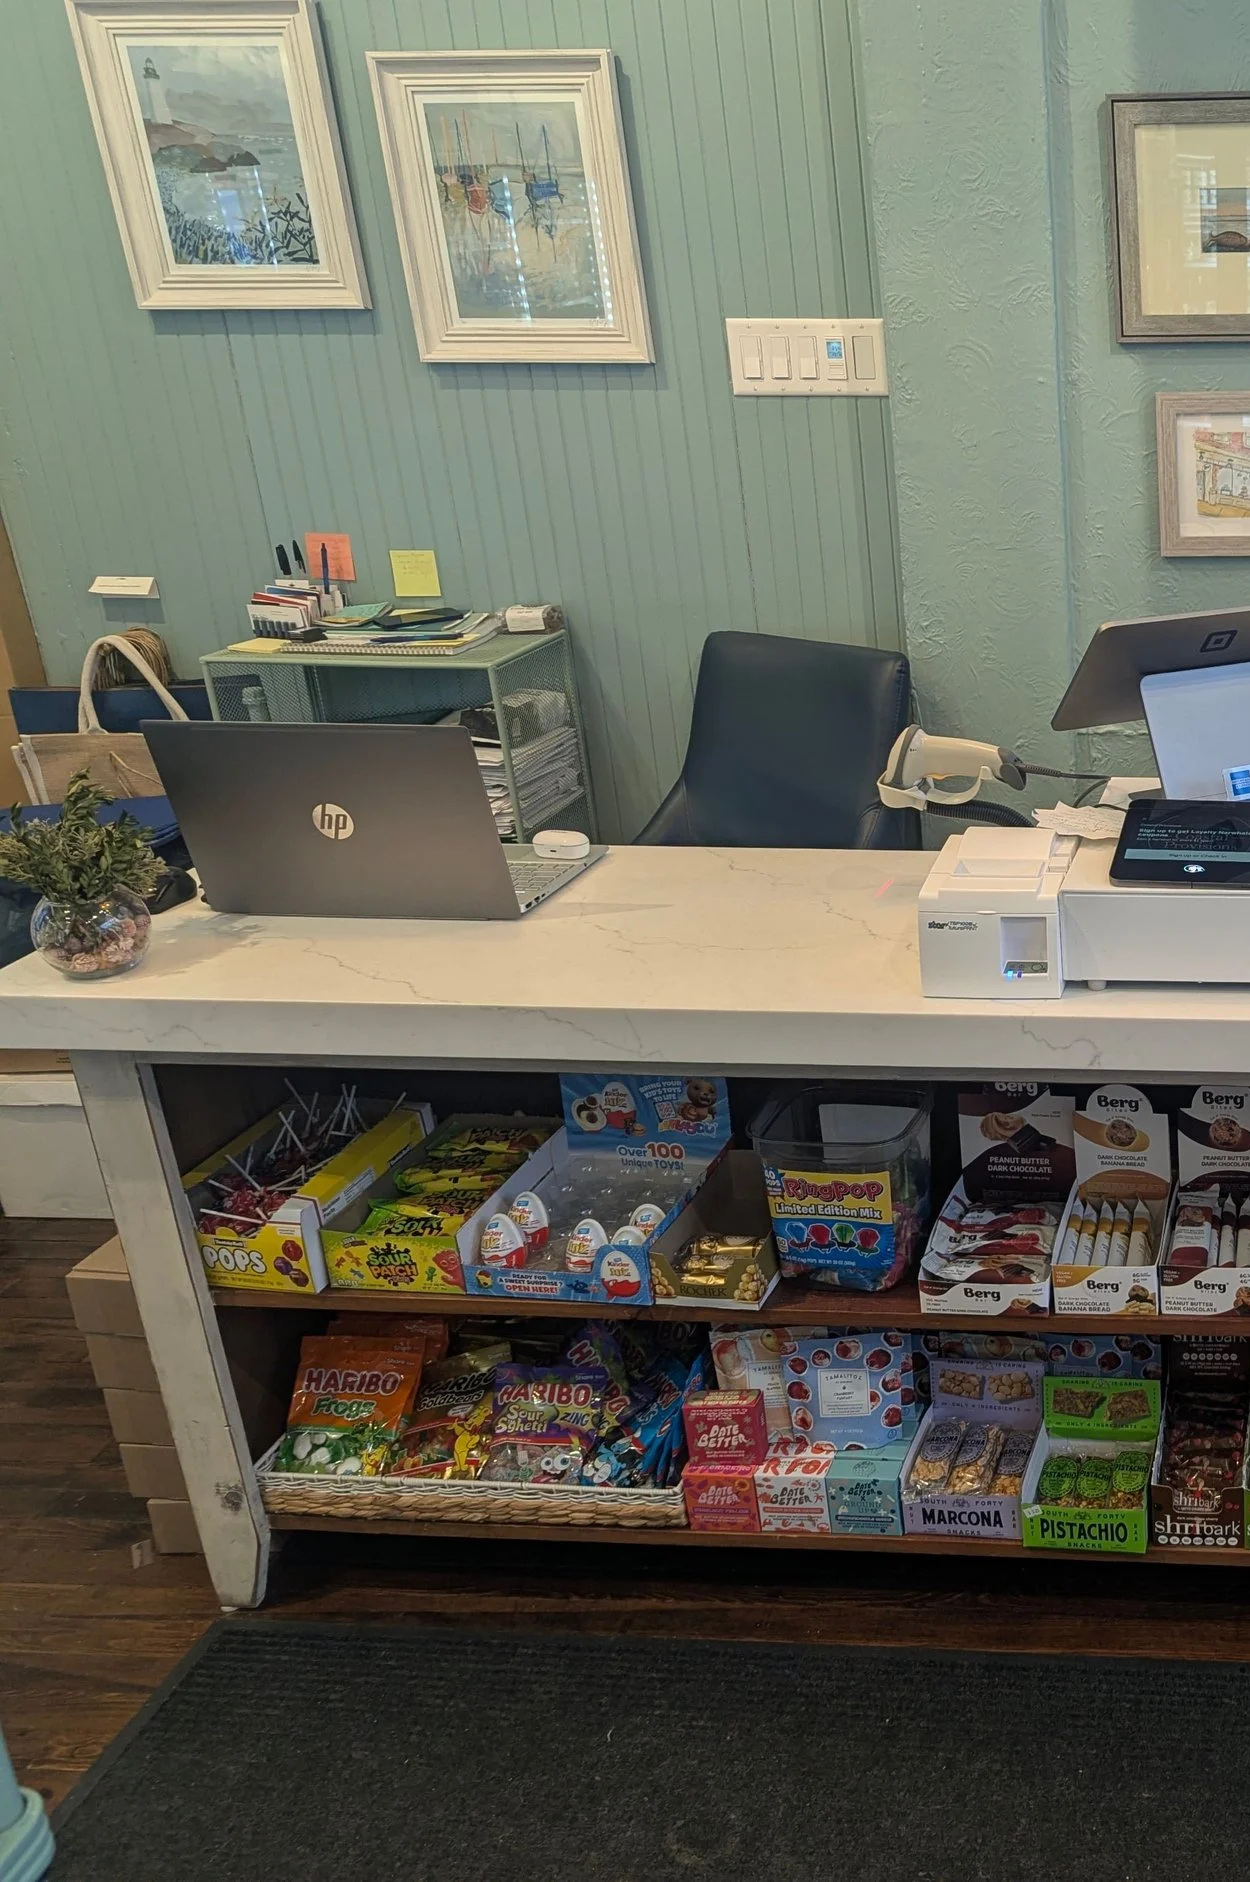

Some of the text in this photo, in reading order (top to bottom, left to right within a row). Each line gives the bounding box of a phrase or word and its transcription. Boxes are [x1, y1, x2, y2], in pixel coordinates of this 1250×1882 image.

[317, 804, 350, 840] hp
[1097, 1095, 1139, 1112] Berg
[1202, 1091, 1244, 1109] Berg
[617, 1142, 684, 1159] Over 100
[621, 1157, 684, 1170] Unique TOYS!
[989, 1157, 1019, 1165] PEANUT
[1009, 1166, 1052, 1174] CHOCOLATE
[775, 1203, 882, 1219] Limited Edition Mix
[202, 1245, 267, 1274] POPS
[368, 1253, 412, 1266] SOUR
[370, 1264, 418, 1277] PATCH
[505, 1278, 557, 1287] SWEET SURPRISE
[1086, 1280, 1119, 1293] Berg
[1194, 1280, 1227, 1293] Berg
[505, 1285, 559, 1294] OPEN HERE!
[680, 1285, 726, 1297] ROCHER
[963, 1287, 1000, 1302] Berg
[303, 1368, 401, 1396] HARIBO
[825, 1373, 863, 1381] TAMALITOZ
[418, 1390, 485, 1411] Goldbears
[498, 1382, 593, 1408] HARIBO
[312, 1397, 377, 1420] Frogs
[507, 1405, 544, 1421] Sour
[494, 1417, 548, 1434] Sghetti
[558, 1411, 589, 1427] ZING
[710, 1424, 739, 1436] DATE
[698, 1432, 749, 1448] BETTER
[1115, 1463, 1149, 1473] PISTACHIO
[1042, 1471, 1076, 1479] PISTACHIO
[708, 1485, 733, 1496] DATE
[780, 1487, 805, 1497] DATE
[847, 1487, 876, 1497] BETTER
[854, 1482, 873, 1491] DATE
[699, 1493, 740, 1505] BETTER
[770, 1494, 812, 1506] BETTER
[922, 1508, 1003, 1527] MARCONA
[1040, 1518, 1127, 1543] PISTACHIO
[1155, 1515, 1240, 1536] shribark
